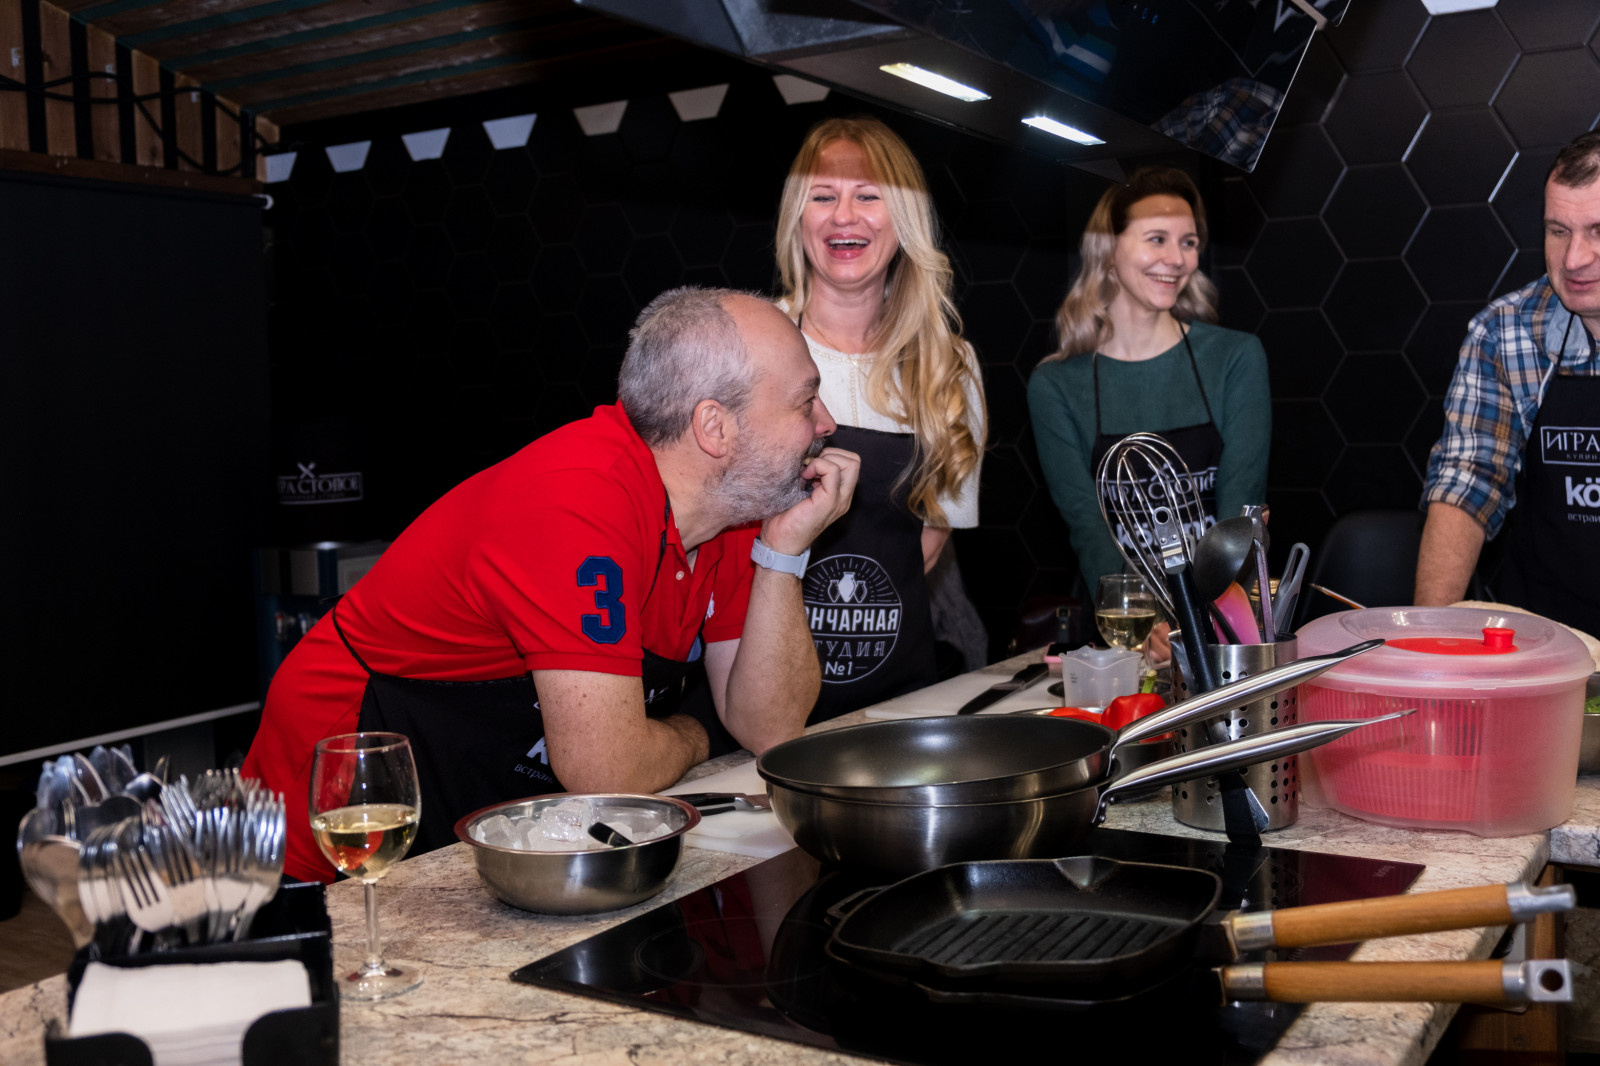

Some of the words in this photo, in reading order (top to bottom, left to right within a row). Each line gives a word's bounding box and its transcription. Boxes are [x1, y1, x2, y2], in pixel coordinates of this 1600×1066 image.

[1546, 431, 1600, 452] ИГРА
[1567, 453, 1600, 461] КУЛИН
[576, 555, 627, 645] 3
